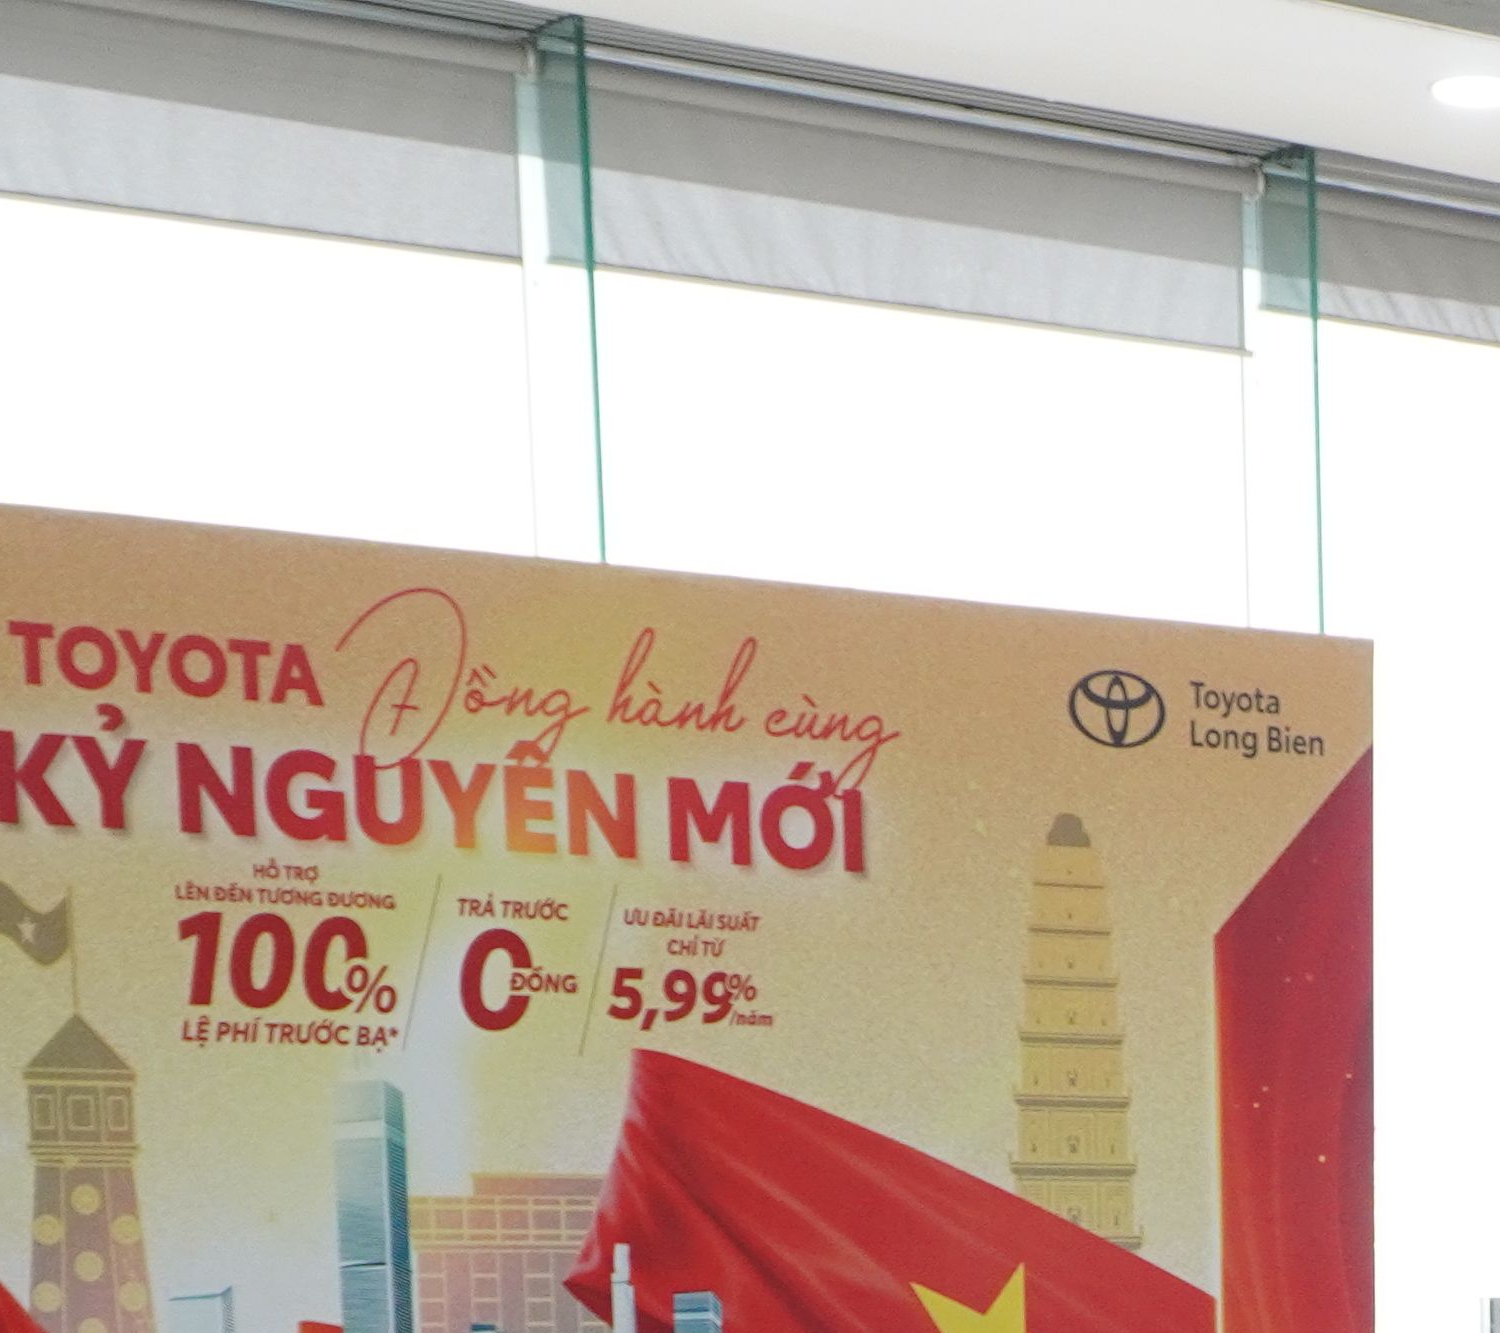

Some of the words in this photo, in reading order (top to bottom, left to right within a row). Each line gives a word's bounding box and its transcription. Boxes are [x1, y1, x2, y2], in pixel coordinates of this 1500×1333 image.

[7, 620, 324, 707] TOYOTA
[606, 627, 747, 733] hành
[764, 694, 899, 799] cùng
[1190, 681, 1281, 718] Toyota
[1190, 721, 1258, 758] Long
[1267, 726, 1325, 756] Bien
[176, 740, 638, 860] NGUYÊN
[667, 762, 866, 873] MỚI
[175, 883, 209, 901] LÊN
[214, 882, 253, 903] ĐẾN
[258, 888, 323, 906] TƯƠNG
[457, 892, 496, 917] TRẢ
[502, 896, 570, 921] TRƯỚC
[716, 909, 761, 932] SUẤT
[510, 966, 578, 995] ĐỒNG
[182, 1014, 210, 1048] LỆ
[216, 1017, 261, 1043] PHÍ
[265, 1018, 350, 1046] TRƯỚC
